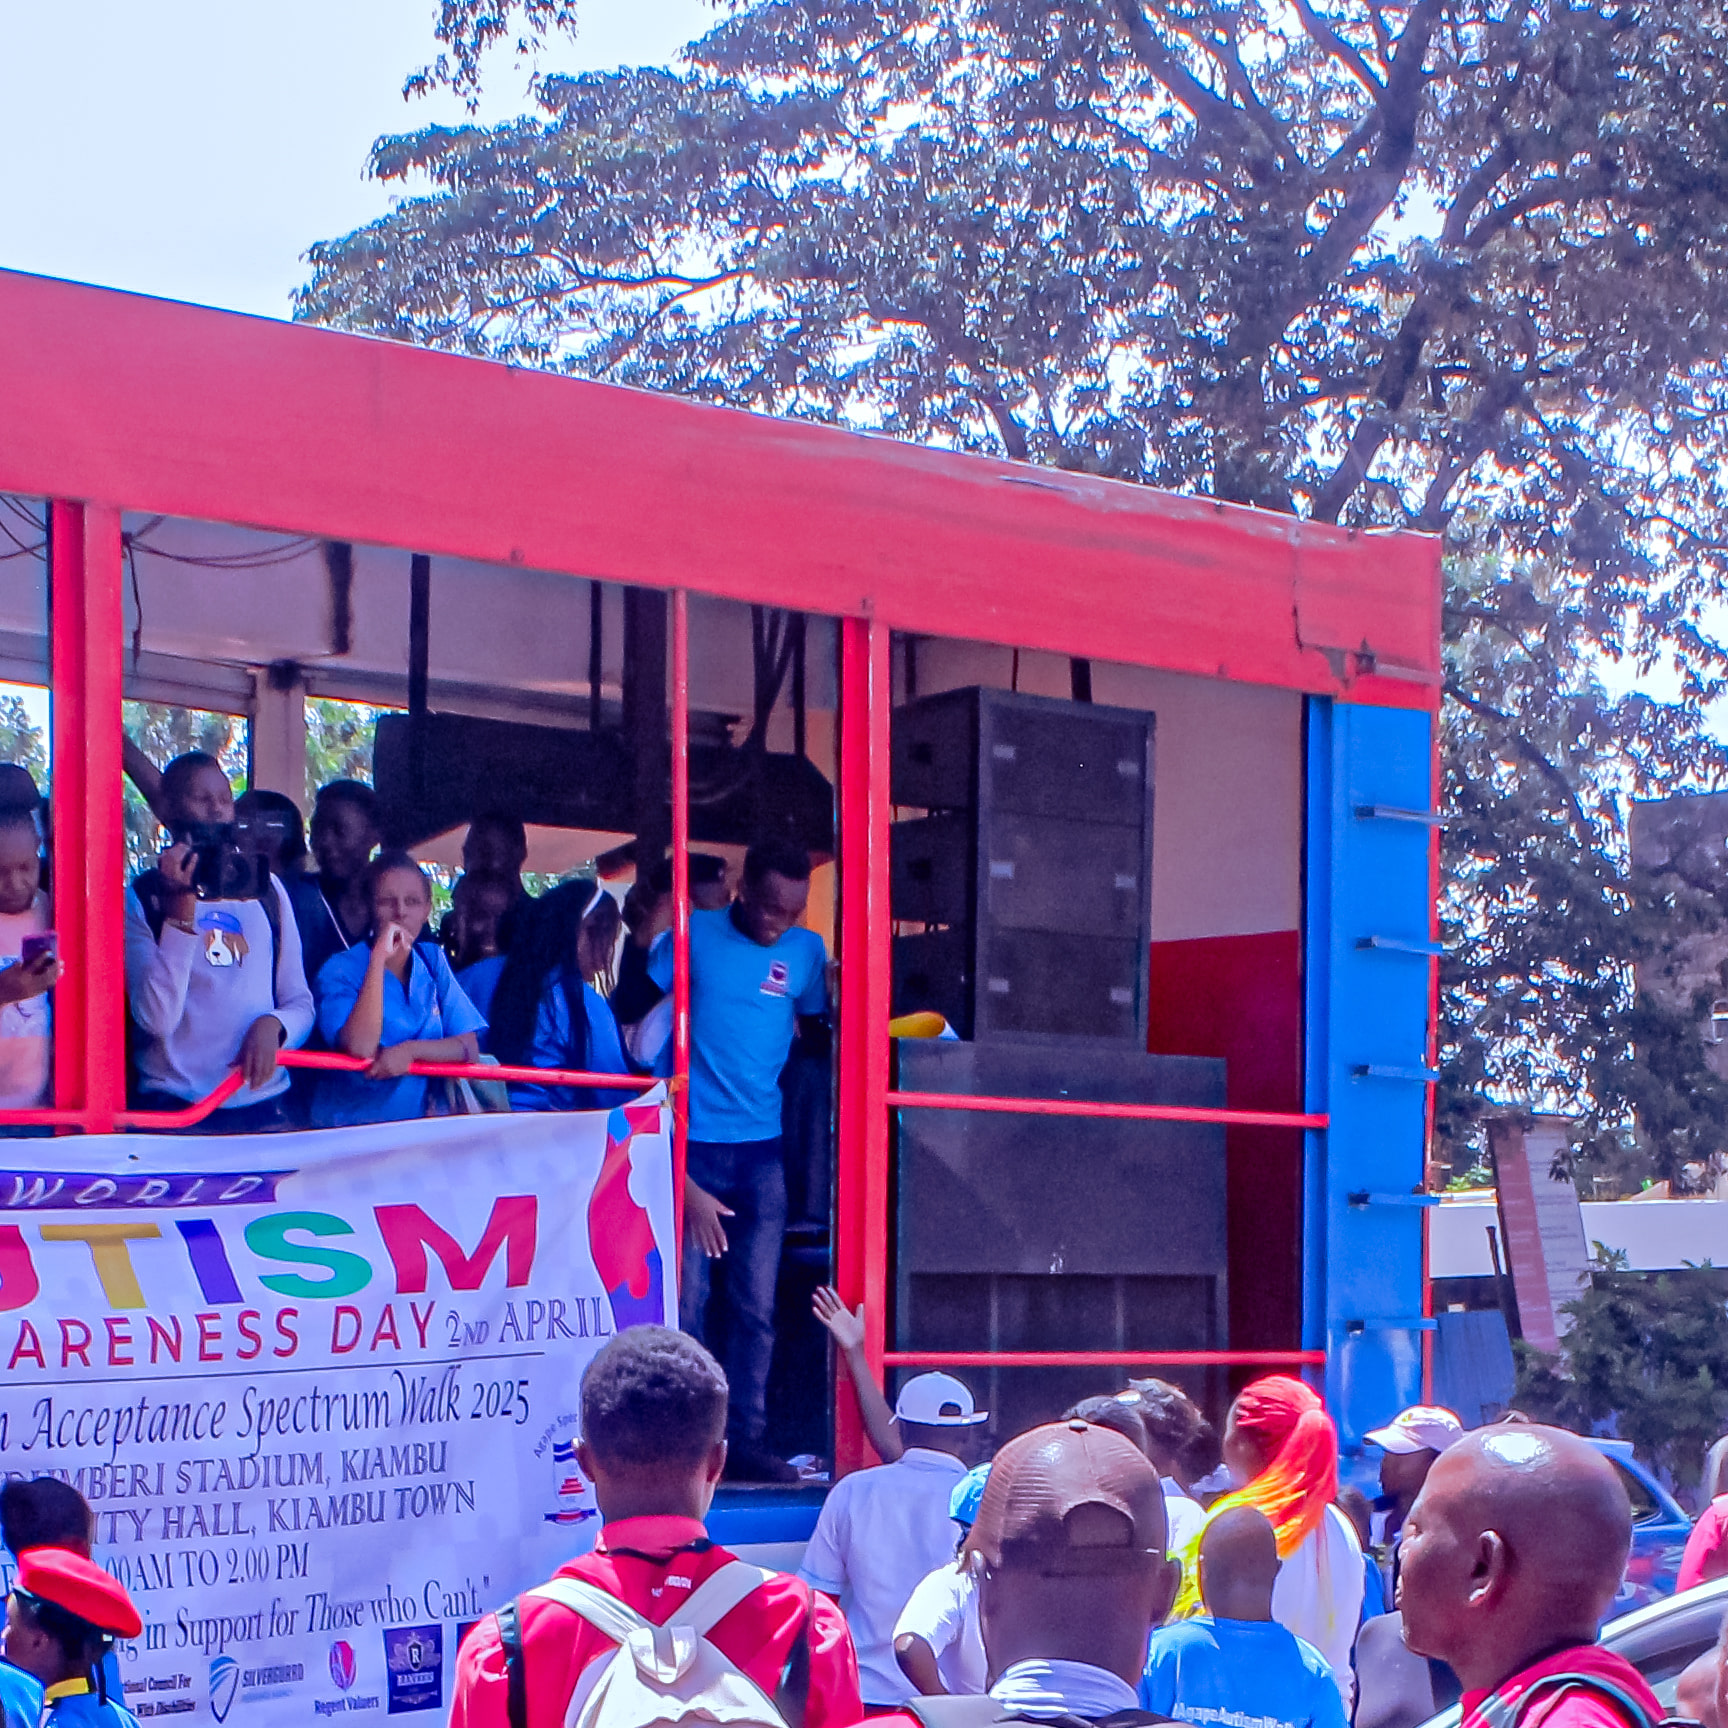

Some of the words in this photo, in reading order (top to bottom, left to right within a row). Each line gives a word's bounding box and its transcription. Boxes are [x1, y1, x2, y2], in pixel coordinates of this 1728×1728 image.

[8, 1174, 268, 1207] WORLD
[329, 1300, 438, 1355] DAY
[499, 1296, 615, 1343] APRIL
[23, 1396, 226, 1465] Acceptance
[237, 1385, 393, 1456] Spectrum
[393, 1365, 461, 1425] Walk
[470, 1380, 530, 1425] 2025
[176, 1451, 331, 1495] STADIUM,
[341, 1440, 448, 1483] KIAMBU
[162, 1502, 257, 1540] HALL,
[268, 1489, 385, 1533] KIAMBU
[394, 1480, 476, 1520] TOWN
[180, 1550, 219, 1587] TO
[227, 1547, 270, 1583] 2.00
[276, 1542, 309, 1579] PM
[145, 1610, 166, 1650] in
[175, 1604, 264, 1655] Support
[269, 1598, 299, 1639] for
[305, 1592, 364, 1634] Those
[372, 1584, 416, 1625] who
